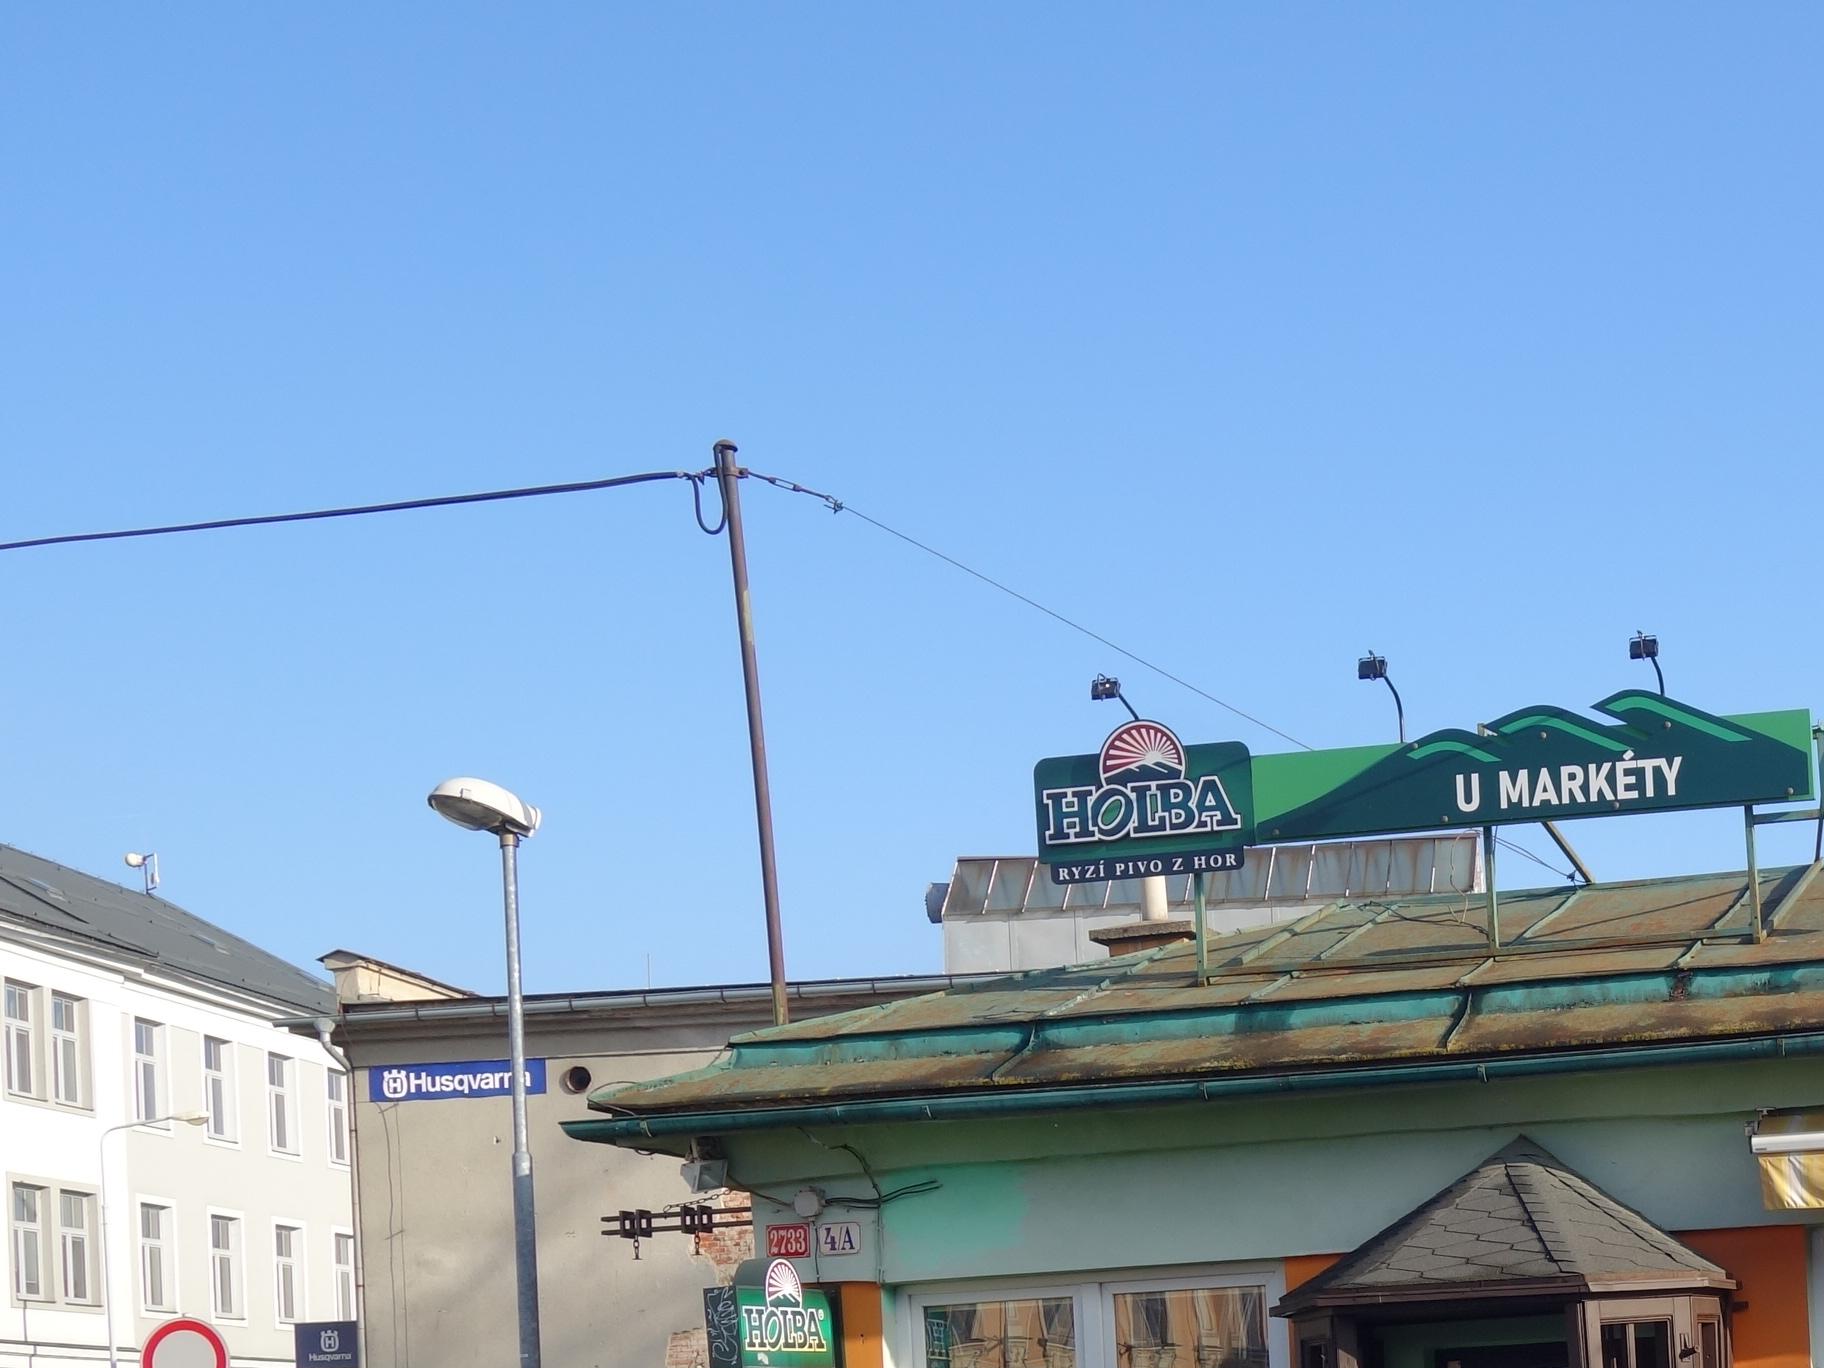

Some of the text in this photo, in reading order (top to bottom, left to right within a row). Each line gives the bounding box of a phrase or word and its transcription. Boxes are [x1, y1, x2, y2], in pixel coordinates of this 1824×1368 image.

[1455, 749, 1683, 812] U MARKÉTY
[1043, 775, 1242, 845] HOLBA
[1058, 853, 1237, 881] RYZÍ PIVO Z HOR
[770, 1229, 806, 1255] 2733
[824, 1225, 855, 1251] 4/A
[742, 1305, 827, 1352] HOLBA
[308, 1352, 352, 1362] Husqvarna
